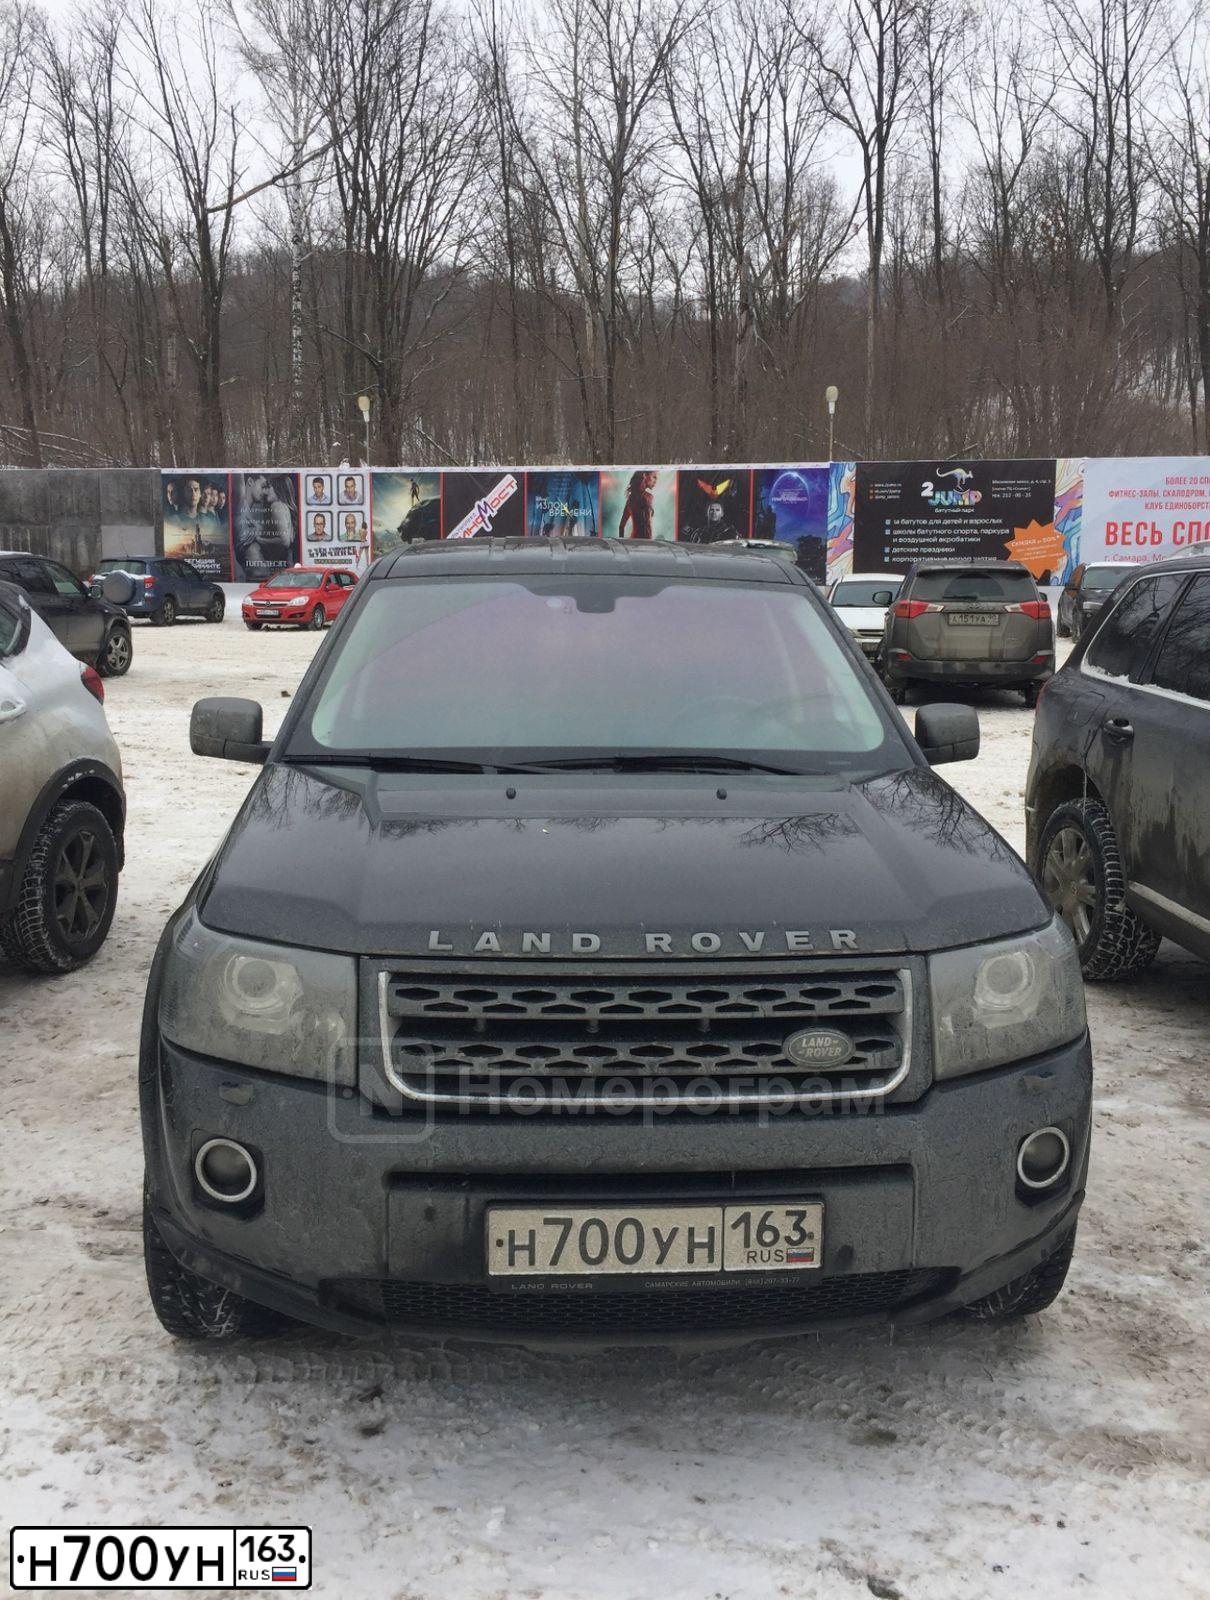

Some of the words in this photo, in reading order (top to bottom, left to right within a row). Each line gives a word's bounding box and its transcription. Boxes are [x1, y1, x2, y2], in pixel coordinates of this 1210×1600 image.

[920, 481, 934, 497] 2
[1165, 476, 1187, 486] БОЛЕЕ
[1189, 476, 1199, 485] 20
[1200, 476, 1210, 485] СП
[928, 490, 982, 506] JUMP
[1144, 502, 1162, 510] КЛУБ
[549, 508, 592, 517] ВРЕМЕНИ
[1105, 521, 1163, 546] ВЕСЬ
[428, 930, 602, 954] LAND
[645, 929, 860, 954] ROVER
[731, 1209, 808, 1249] 163
[507, 1217, 716, 1267] Н700УН
[746, 1250, 785, 1264] RUS
[551, 1282, 593, 1290] ROVER
